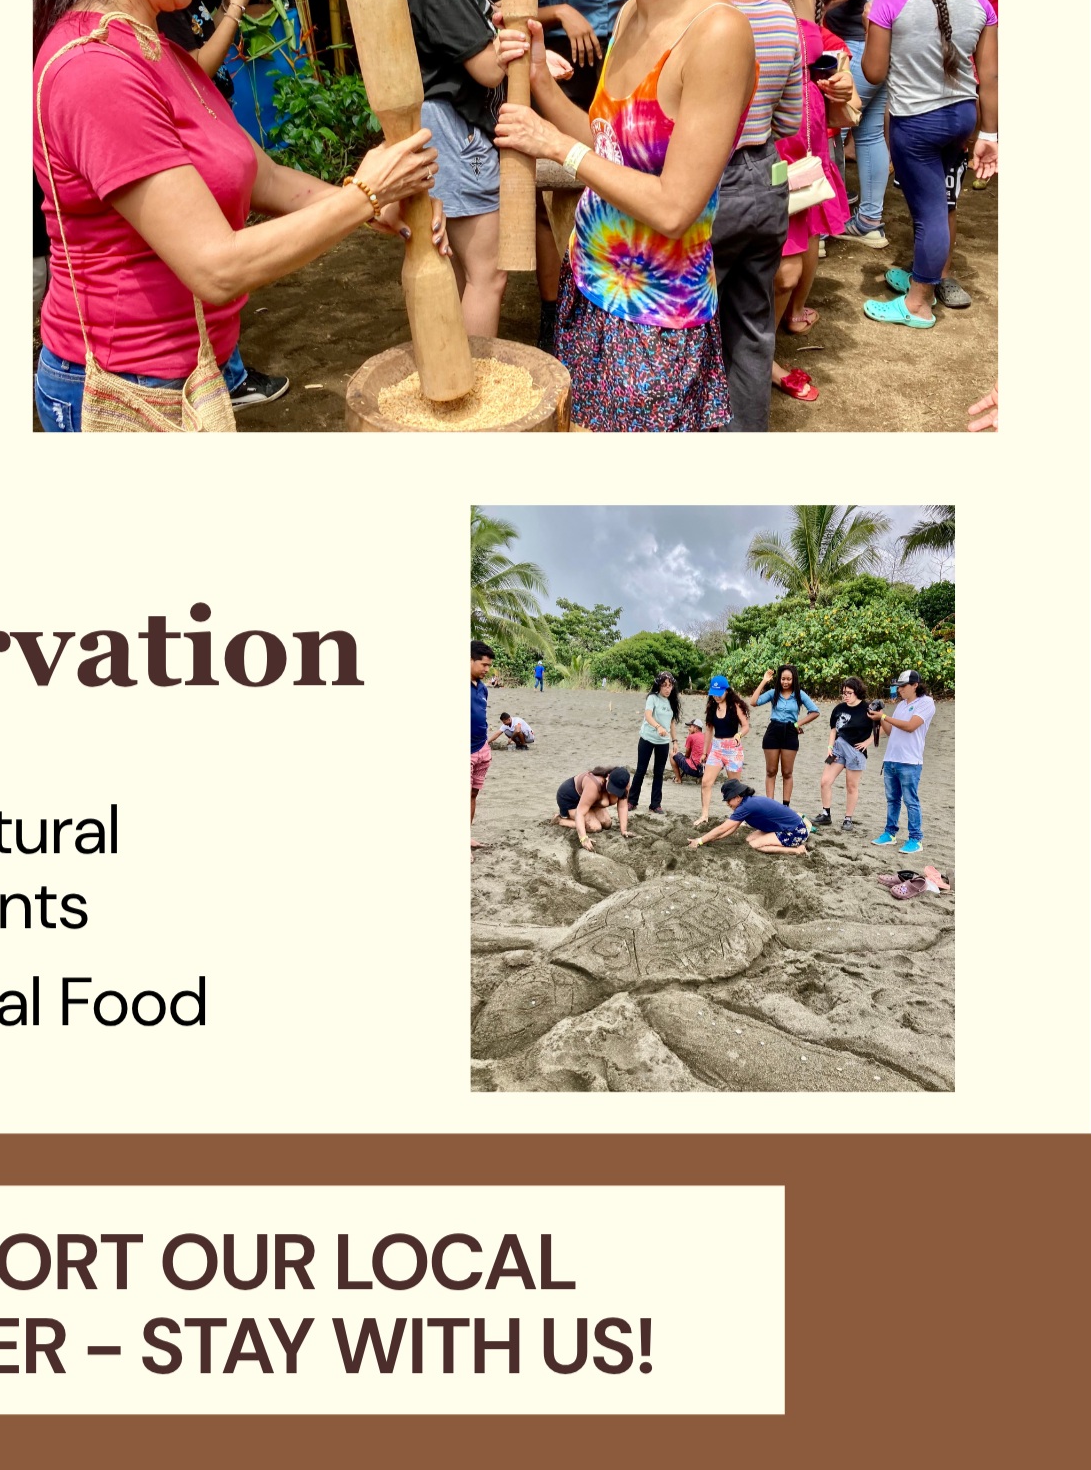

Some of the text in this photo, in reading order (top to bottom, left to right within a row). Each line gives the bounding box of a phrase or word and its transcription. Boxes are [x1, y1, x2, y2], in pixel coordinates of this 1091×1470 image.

[62, 976, 205, 1027] Food
[162, 1233, 315, 1291] OUR
[338, 1233, 576, 1291] LOCAL
[142, 1317, 315, 1375] STAY
[332, 1318, 520, 1374] WITH
[543, 1317, 652, 1375] US!
